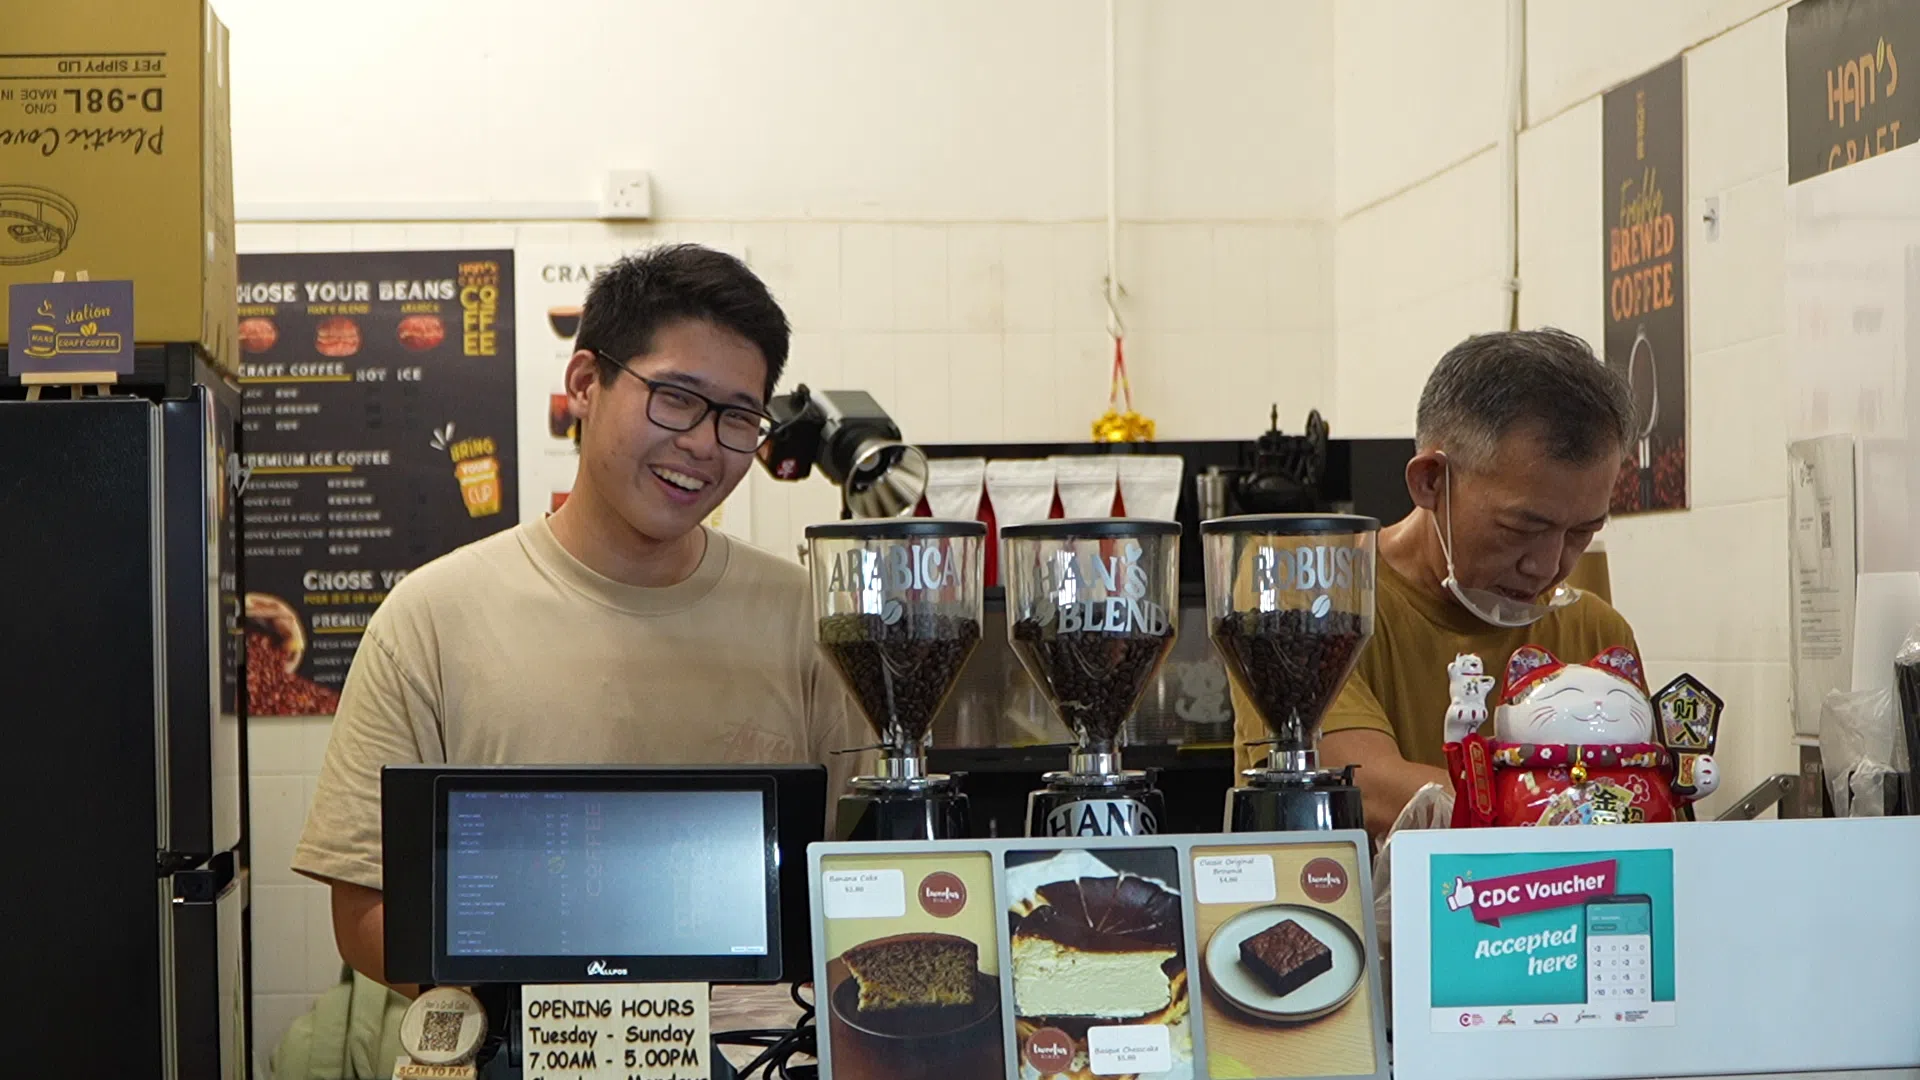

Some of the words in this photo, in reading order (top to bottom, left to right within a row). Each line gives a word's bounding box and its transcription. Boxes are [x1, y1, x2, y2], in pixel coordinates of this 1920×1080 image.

[58, 61, 81, 73] LID
[84, 60, 128, 73] SIPPY
[132, 60, 161, 72] PET
[1827, 37, 1898, 128] HAN'S
[0, 90, 13, 100] IN
[21, 89, 56, 100] MADE
[64, 88, 162, 113] D-98L
[21, 103, 56, 114] C/NO.
[65, 125, 163, 155] Plastic
[1611, 214, 1674, 271] BREWED
[304, 281, 371, 302] YOUR
[379, 279, 456, 301] BEANS
[1611, 262, 1673, 321] COFFEE
[65, 302, 112, 325] station
[238, 363, 283, 377] CRAFT
[290, 362, 344, 376] COFFEE
[397, 367, 422, 381] ICE
[310, 452, 333, 466] ICE
[337, 450, 390, 466] COFFEE
[829, 545, 960, 592] ARABICA
[1034, 553, 1149, 600] HAN'S
[303, 570, 373, 591] CHOSE
[312, 614, 372, 628] PREMIU
[1058, 597, 1170, 637] BLEND
[1049, 802, 1157, 836] HAN'S
[860, 874, 878, 882] Cake
[1478, 886, 1520, 908] CDC
[1524, 874, 1606, 901] Voucher
[1474, 924, 1577, 960] Accepted
[1527, 953, 1578, 976] here
[528, 1001, 612, 1018] OPENING
[622, 999, 695, 1018] HOURS
[529, 1025, 598, 1048] Tuesday
[625, 1023, 695, 1046] Sunday
[529, 1050, 597, 1070] 7.00AM
[624, 1048, 699, 1068] 5.00PM
[399, 1066, 428, 1076] SCAN
[431, 1067, 446, 1077] TO
[448, 1067, 470, 1077] PAY
